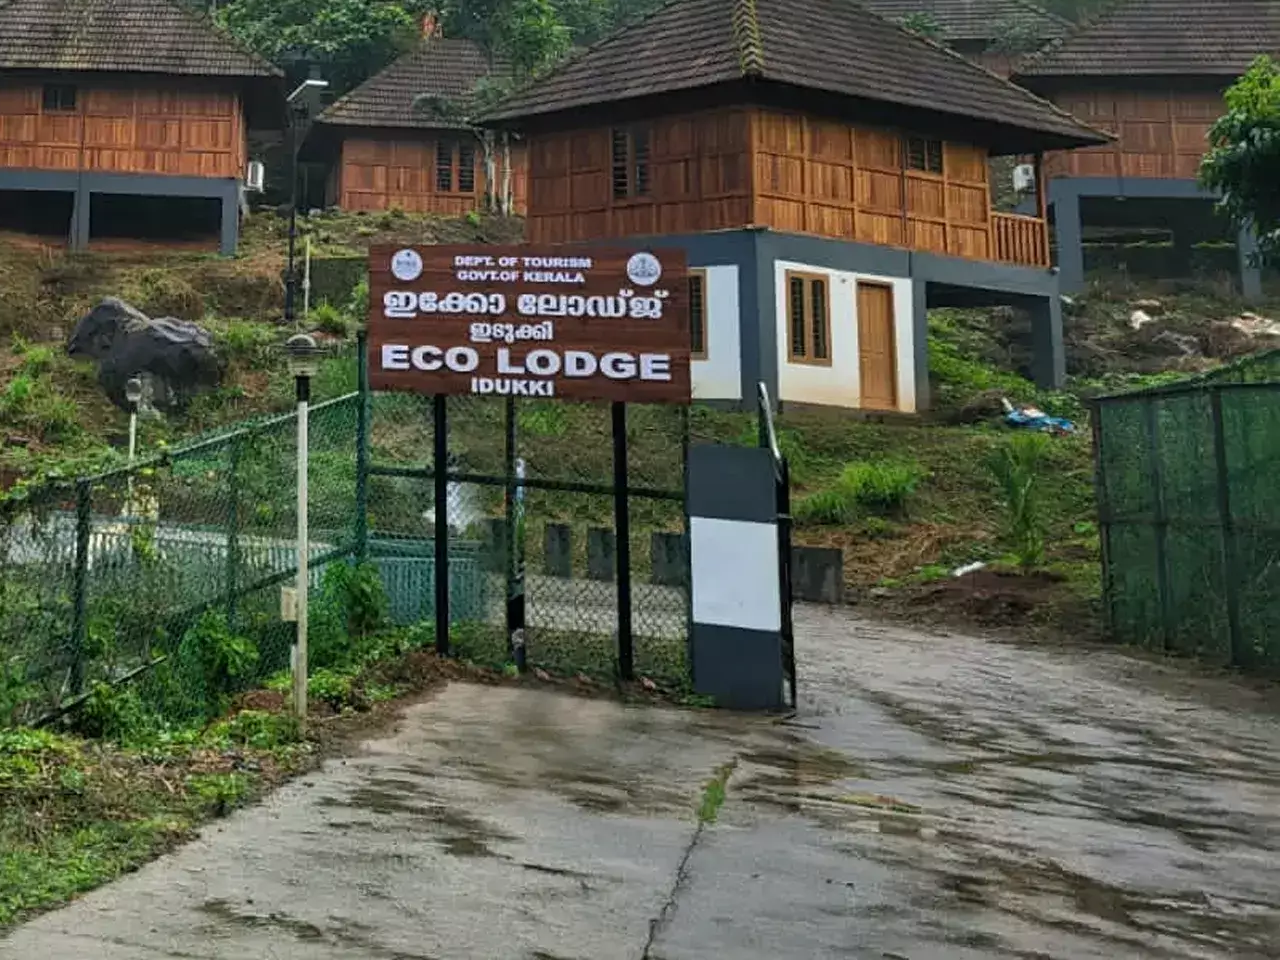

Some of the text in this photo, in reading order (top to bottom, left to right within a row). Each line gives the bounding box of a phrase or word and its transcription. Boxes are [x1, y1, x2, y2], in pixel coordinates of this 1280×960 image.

[454, 255, 593, 269] DEPT. OF TOURISM
[523, 272, 585, 283] KERALA
[383, 289, 669, 319] ഇക്കോ ലോഡ്ജ്
[470, 320, 553, 343] ഇടുക്കി
[381, 344, 672, 381] ECO LODGE
[471, 377, 554, 396] IDUKKI
